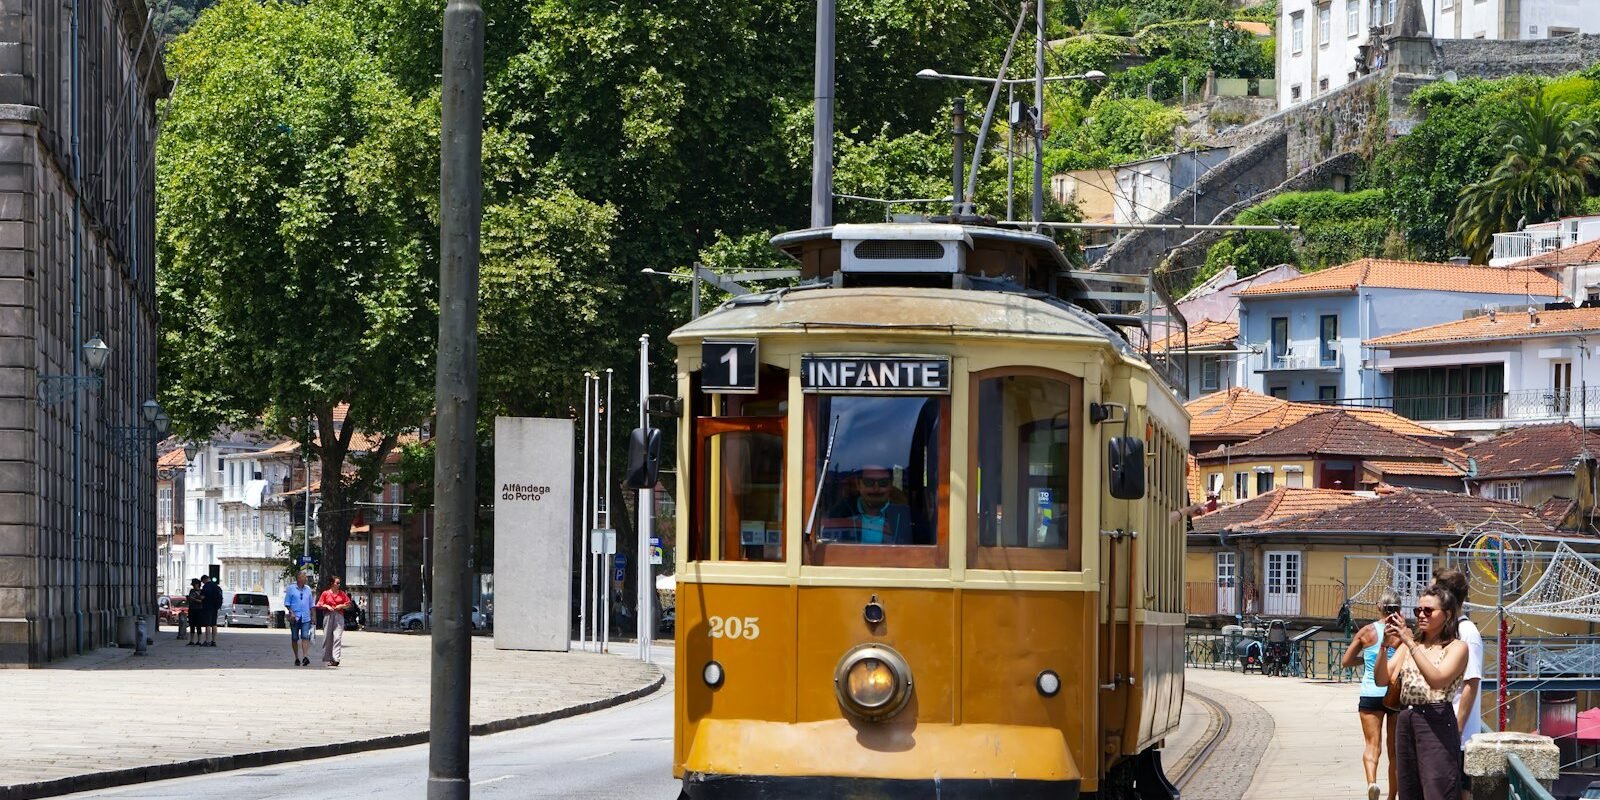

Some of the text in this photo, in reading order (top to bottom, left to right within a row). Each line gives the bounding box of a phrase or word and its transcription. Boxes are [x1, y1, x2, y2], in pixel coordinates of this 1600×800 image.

[720, 347, 738, 385] 1
[809, 362, 940, 387] INFANTE
[502, 484, 551, 495] Alfândega
[502, 492, 541, 501] do Porto
[708, 615, 760, 640] 205
